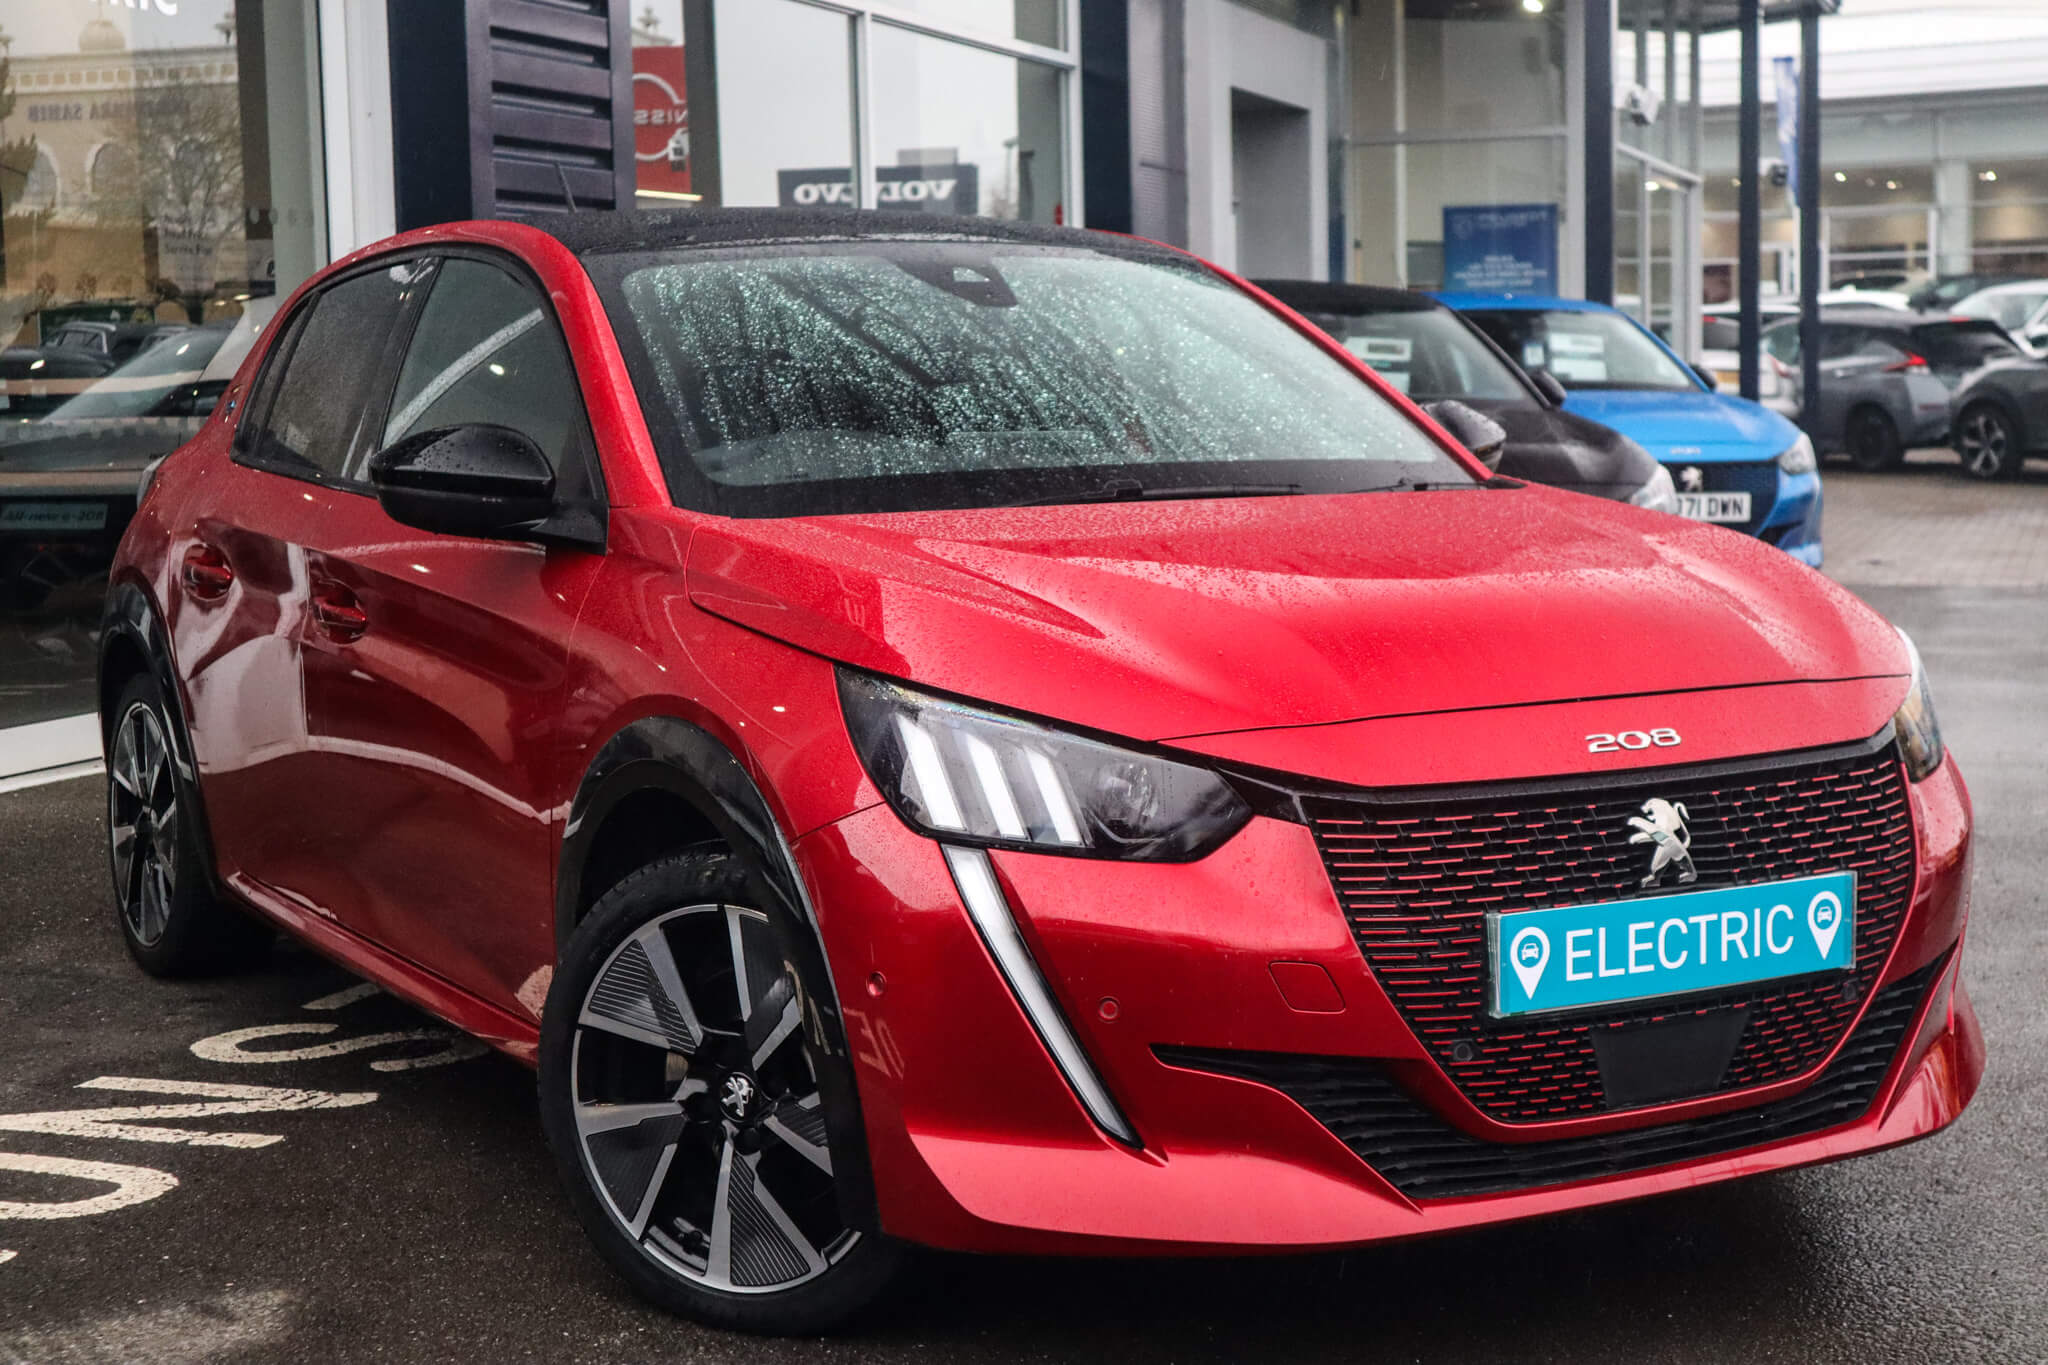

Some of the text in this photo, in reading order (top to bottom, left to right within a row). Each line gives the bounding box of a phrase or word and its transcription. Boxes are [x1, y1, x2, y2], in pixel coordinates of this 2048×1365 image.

[1707, 497, 1743, 517] DWN
[1585, 728, 1682, 753] 208
[1565, 904, 1795, 982] ELECTRIC
